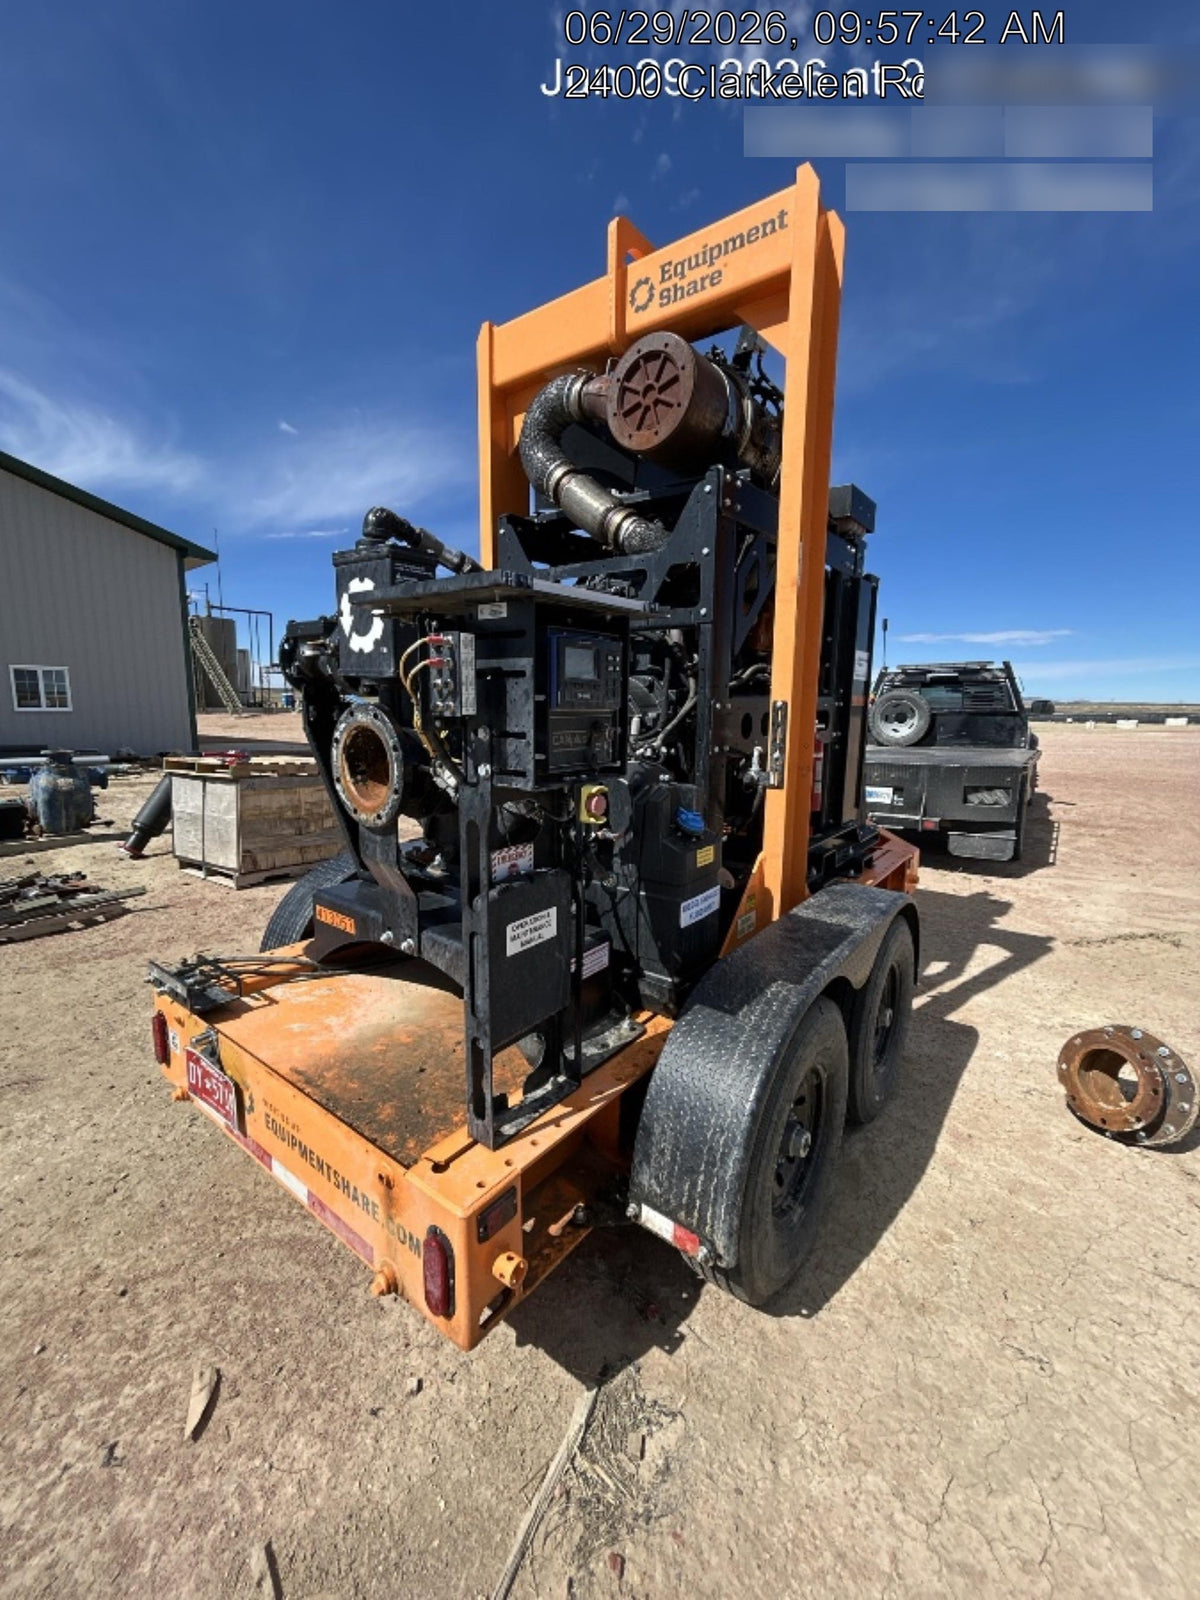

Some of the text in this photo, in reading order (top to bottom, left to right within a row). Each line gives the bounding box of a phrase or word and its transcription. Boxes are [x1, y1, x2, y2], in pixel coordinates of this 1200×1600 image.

[659, 208, 789, 284] Equipment
[658, 268, 723, 308] Share
[264, 1112, 422, 1259] EQUIPMENTSHARE.COM
